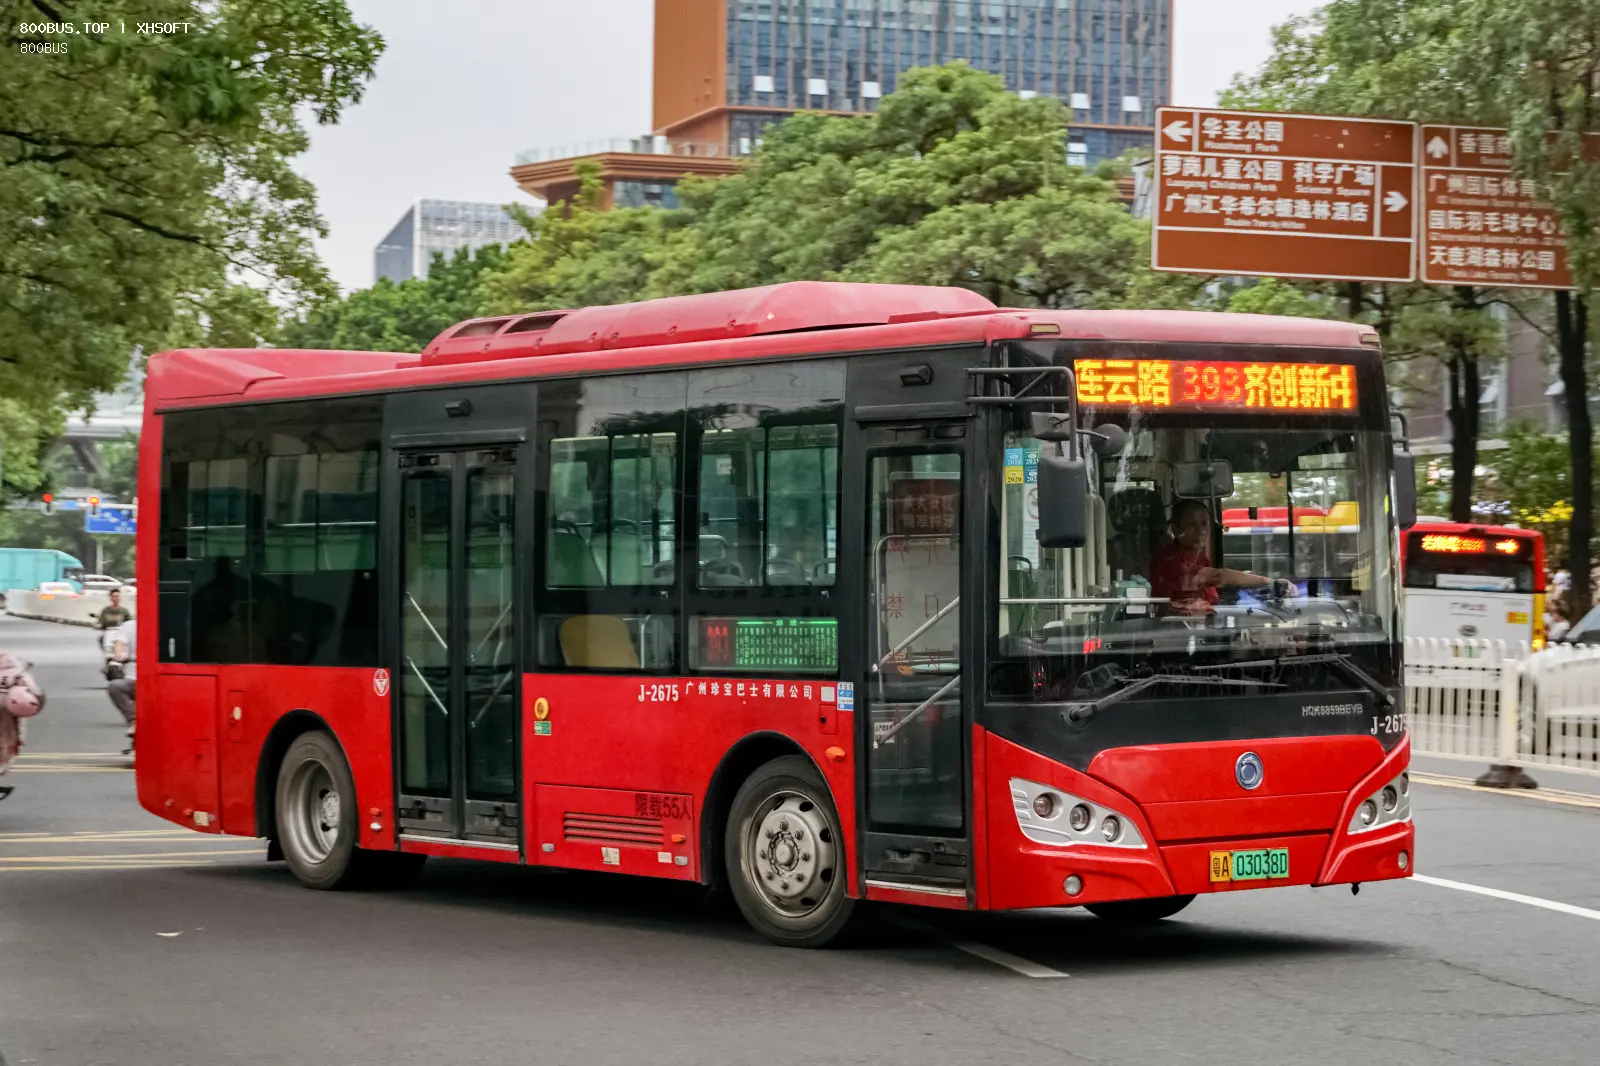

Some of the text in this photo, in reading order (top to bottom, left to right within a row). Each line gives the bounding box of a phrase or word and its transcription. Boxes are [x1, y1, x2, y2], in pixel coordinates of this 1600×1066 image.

[1201, 117, 1284, 142] 华圣公园
[1293, 162, 1375, 186] 科学广场
[1428, 209, 1568, 236] 国际羽毛球中心
[1183, 366, 1241, 401] 393
[638, 684, 679, 702] J-2675
[685, 681, 813, 700] 广州珍宝巴士有限公司
[1236, 852, 1288, 876] 03038D
